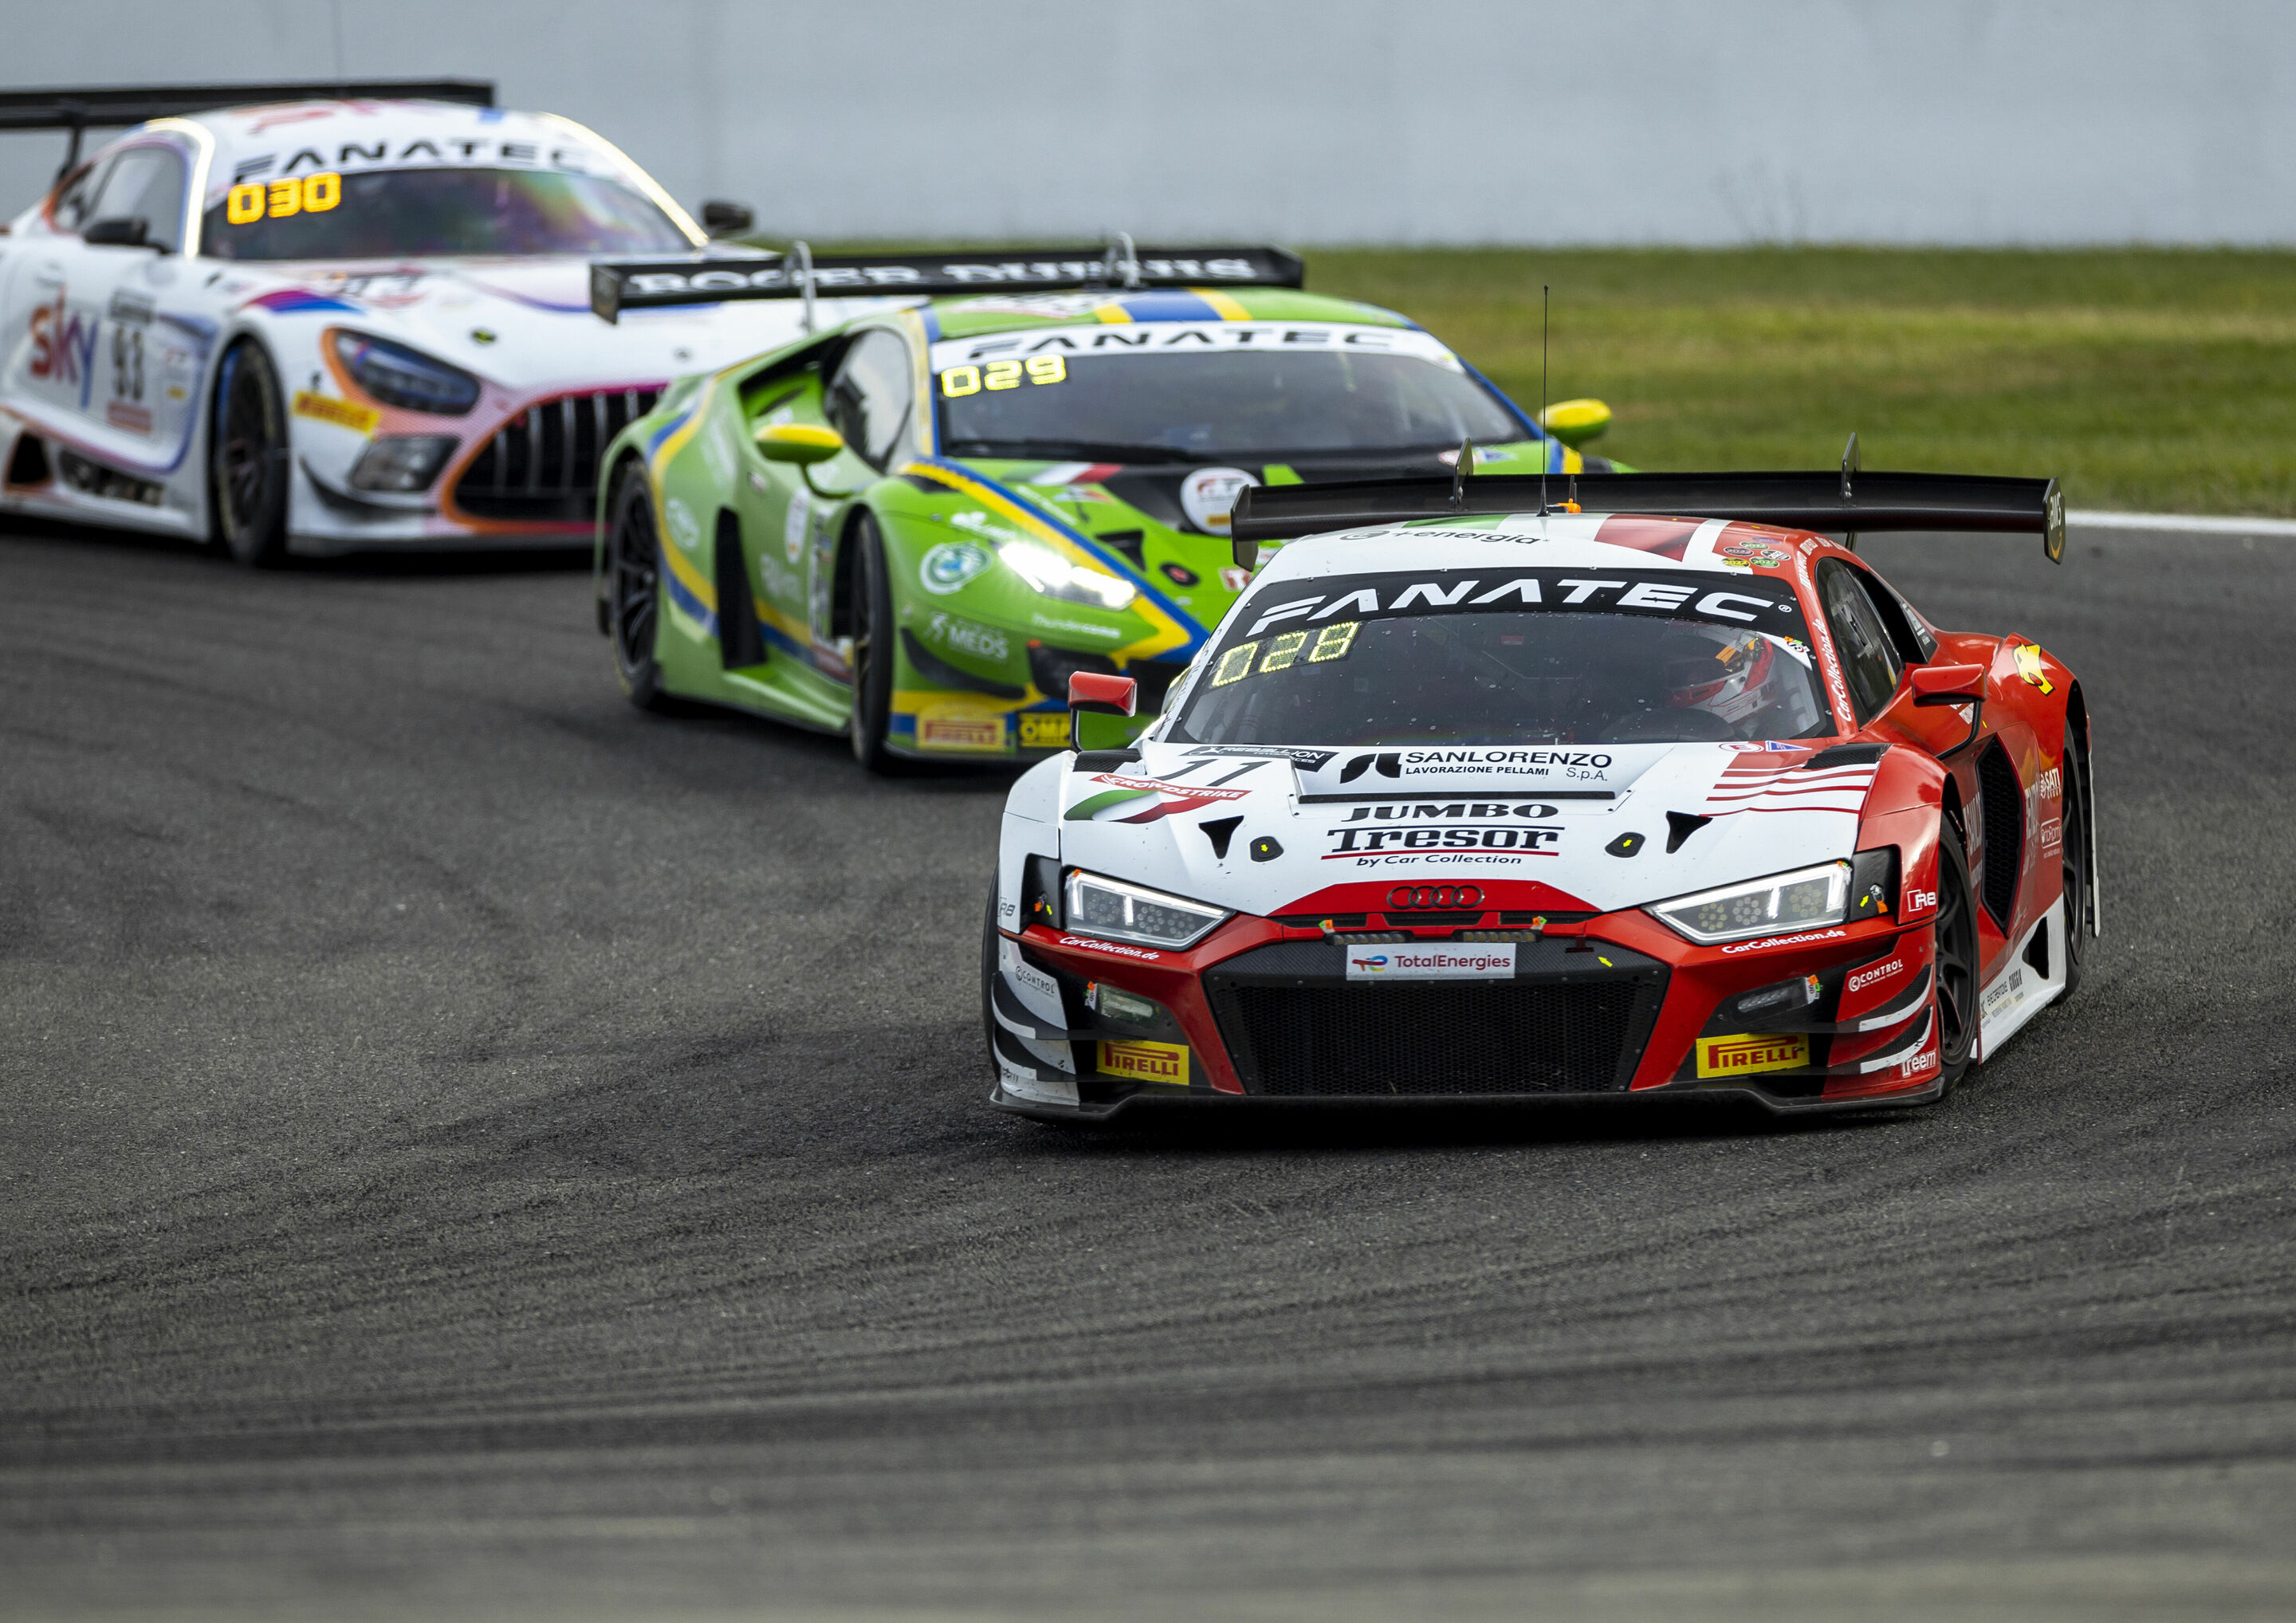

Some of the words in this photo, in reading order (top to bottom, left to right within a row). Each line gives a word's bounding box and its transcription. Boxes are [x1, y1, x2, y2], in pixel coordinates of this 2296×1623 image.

[235, 137, 588, 182] FANATEC
[227, 172, 341, 224] 030
[969, 329, 1394, 359] FANATEC
[941, 354, 1067, 398] 029
[1245, 578, 1774, 637] FANATEC
[1211, 622, 1359, 686] 028
[1221, 747, 1326, 760] REBELLION
[1406, 751, 1612, 768] SANLORENZO
[1406, 766, 1493, 775] LAVORAZIONE
[1496, 766, 1550, 776] PELLAMI
[1566, 768, 1609, 782] S.p.A.
[1111, 777, 1244, 798] CROWDSTRIKE
[1341, 803, 1559, 823] JUMBO
[1327, 828, 1559, 853] Tresor
[1356, 858, 1382, 868] by
[1385, 855, 1421, 865] Car
[1425, 855, 1522, 864] Collection
[1915, 891, 1937, 909] R8
[1060, 936, 1160, 960] CarCollection.de
[1721, 929, 1847, 954] CarCollection.de
[1394, 955, 1512, 972] TotalEnergies
[1860, 959, 1904, 983] CONTROL
[1105, 1043, 1180, 1076] PIRELLI
[1708, 1036, 1799, 1069] PIRELLI
